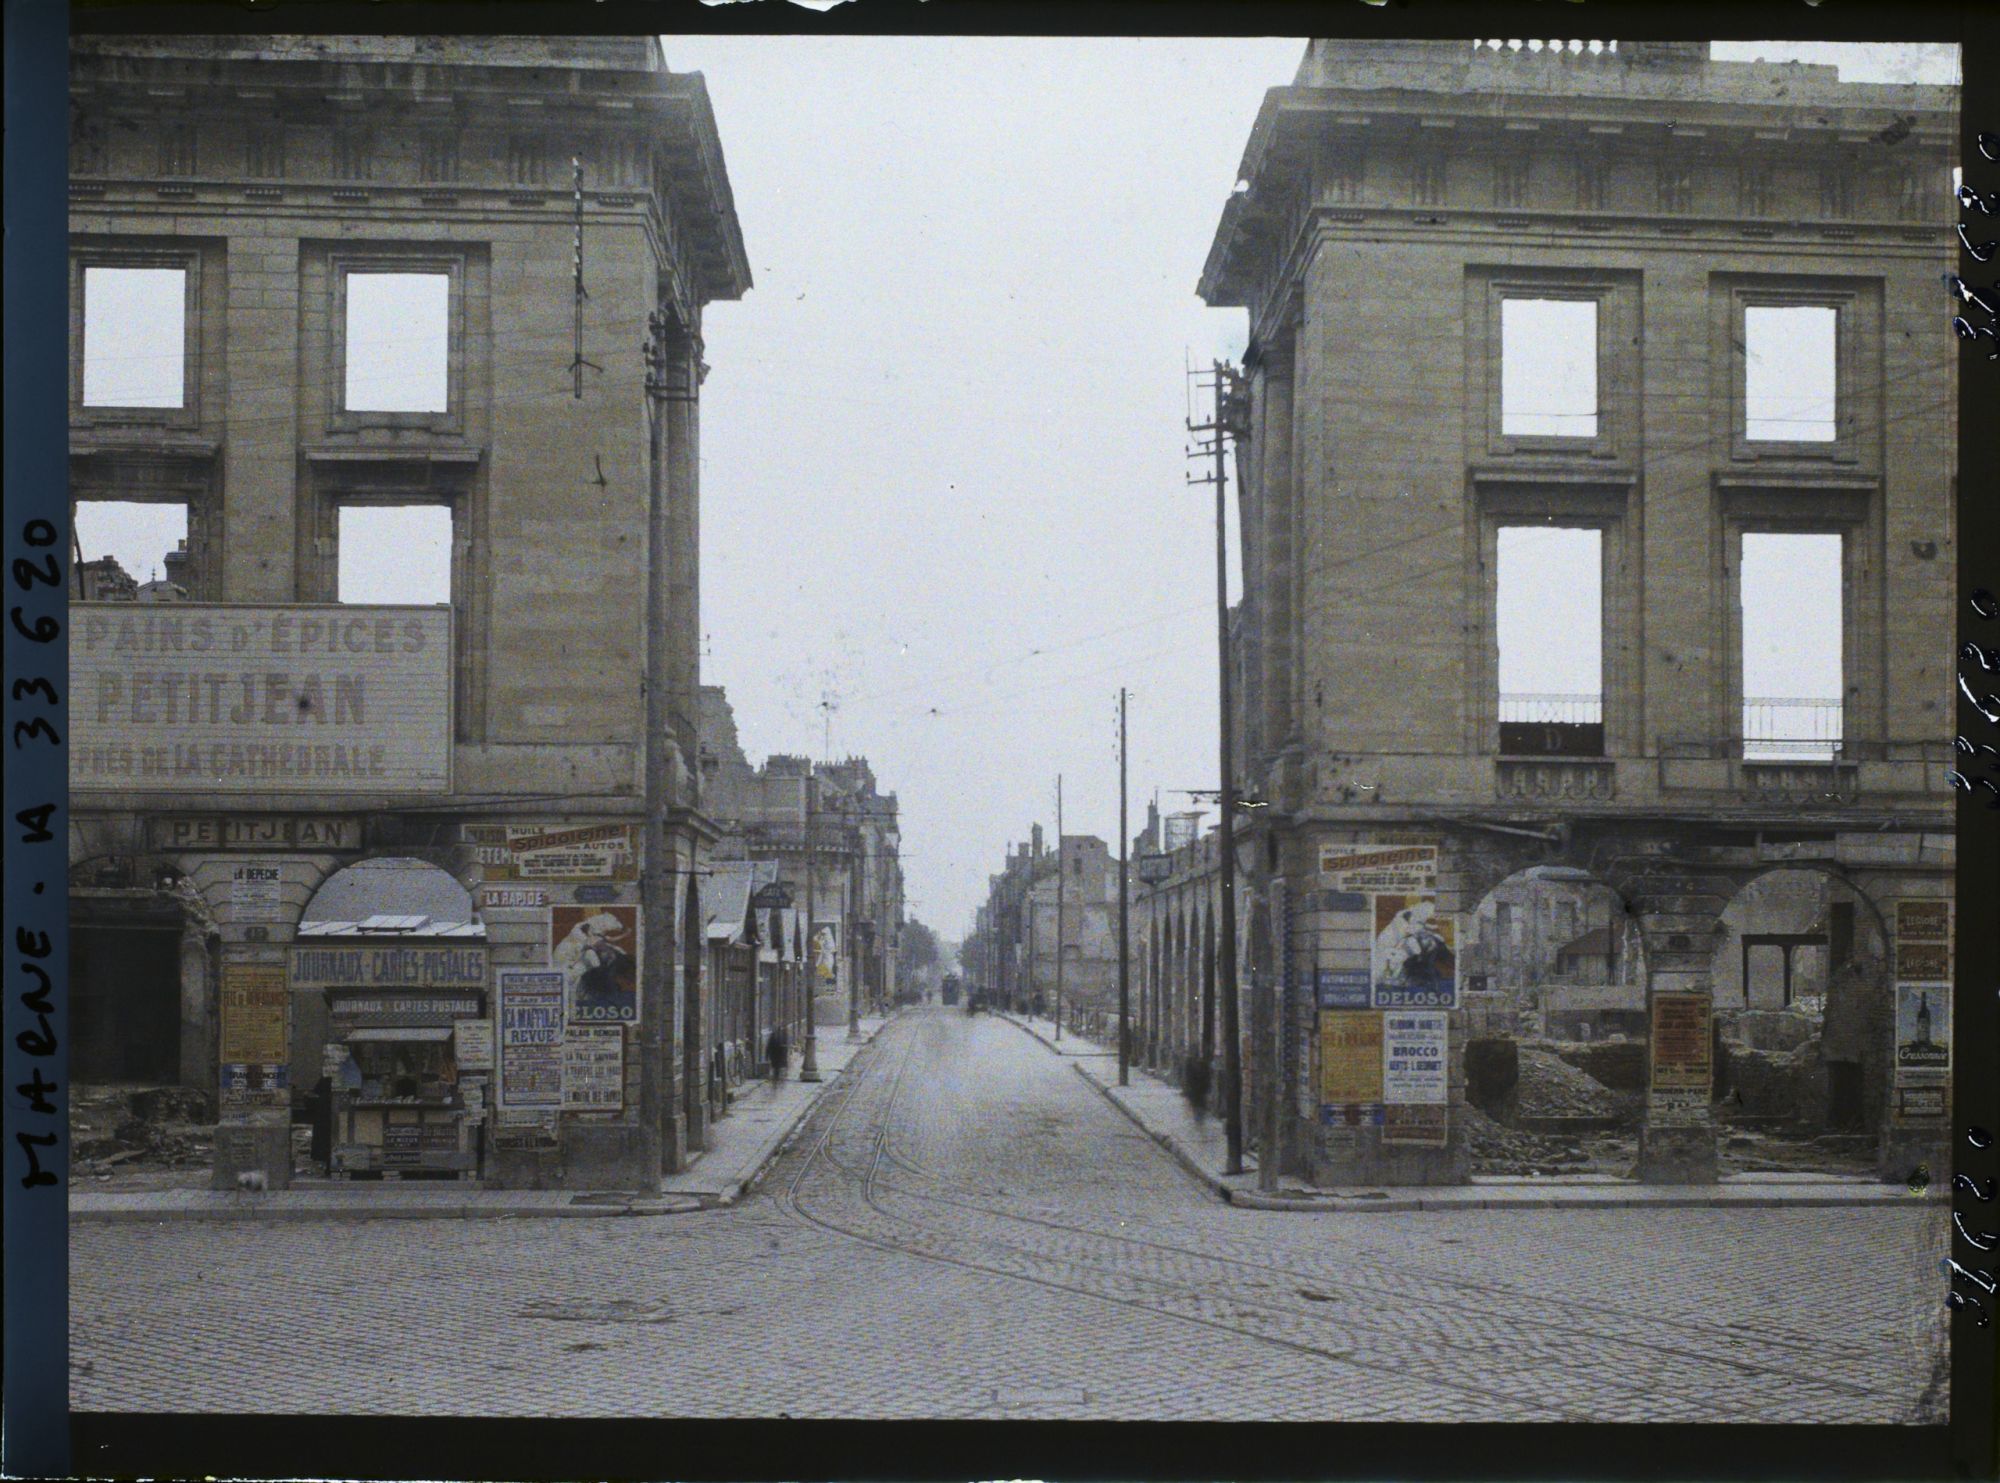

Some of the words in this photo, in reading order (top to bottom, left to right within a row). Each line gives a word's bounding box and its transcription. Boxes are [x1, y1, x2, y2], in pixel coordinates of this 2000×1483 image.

[86, 615, 212, 652] PAINS
[98, 672, 365, 725] PETITJEAN
[174, 744, 201, 776] LA
[173, 821, 343, 846] PETITJEAN
[1377, 991, 1452, 1005] DELOSO
[574, 1005, 633, 1020] ELOSO
[511, 1030, 555, 1044] REVUE
[16, 925, 58, 1190] MARNE
